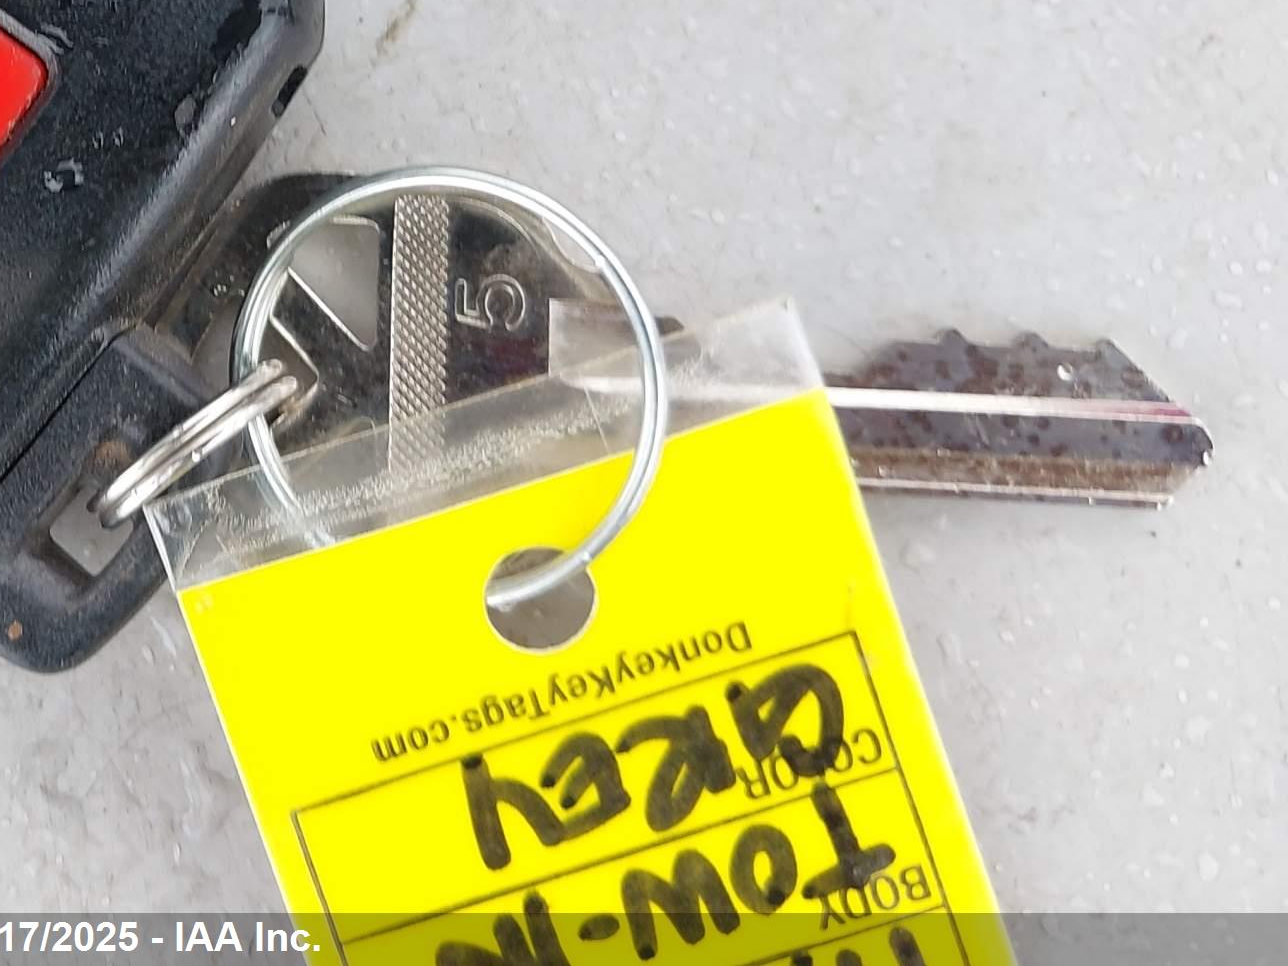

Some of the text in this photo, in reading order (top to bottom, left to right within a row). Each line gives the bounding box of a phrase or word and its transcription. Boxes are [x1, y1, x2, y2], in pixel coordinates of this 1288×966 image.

[455, 273, 525, 331] 5
[371, 621, 752, 765] DonkeyKeyTags.com
[462, 663, 843, 870] GREY
[739, 726, 883, 802] COOR
[819, 865, 932, 930] BODY
